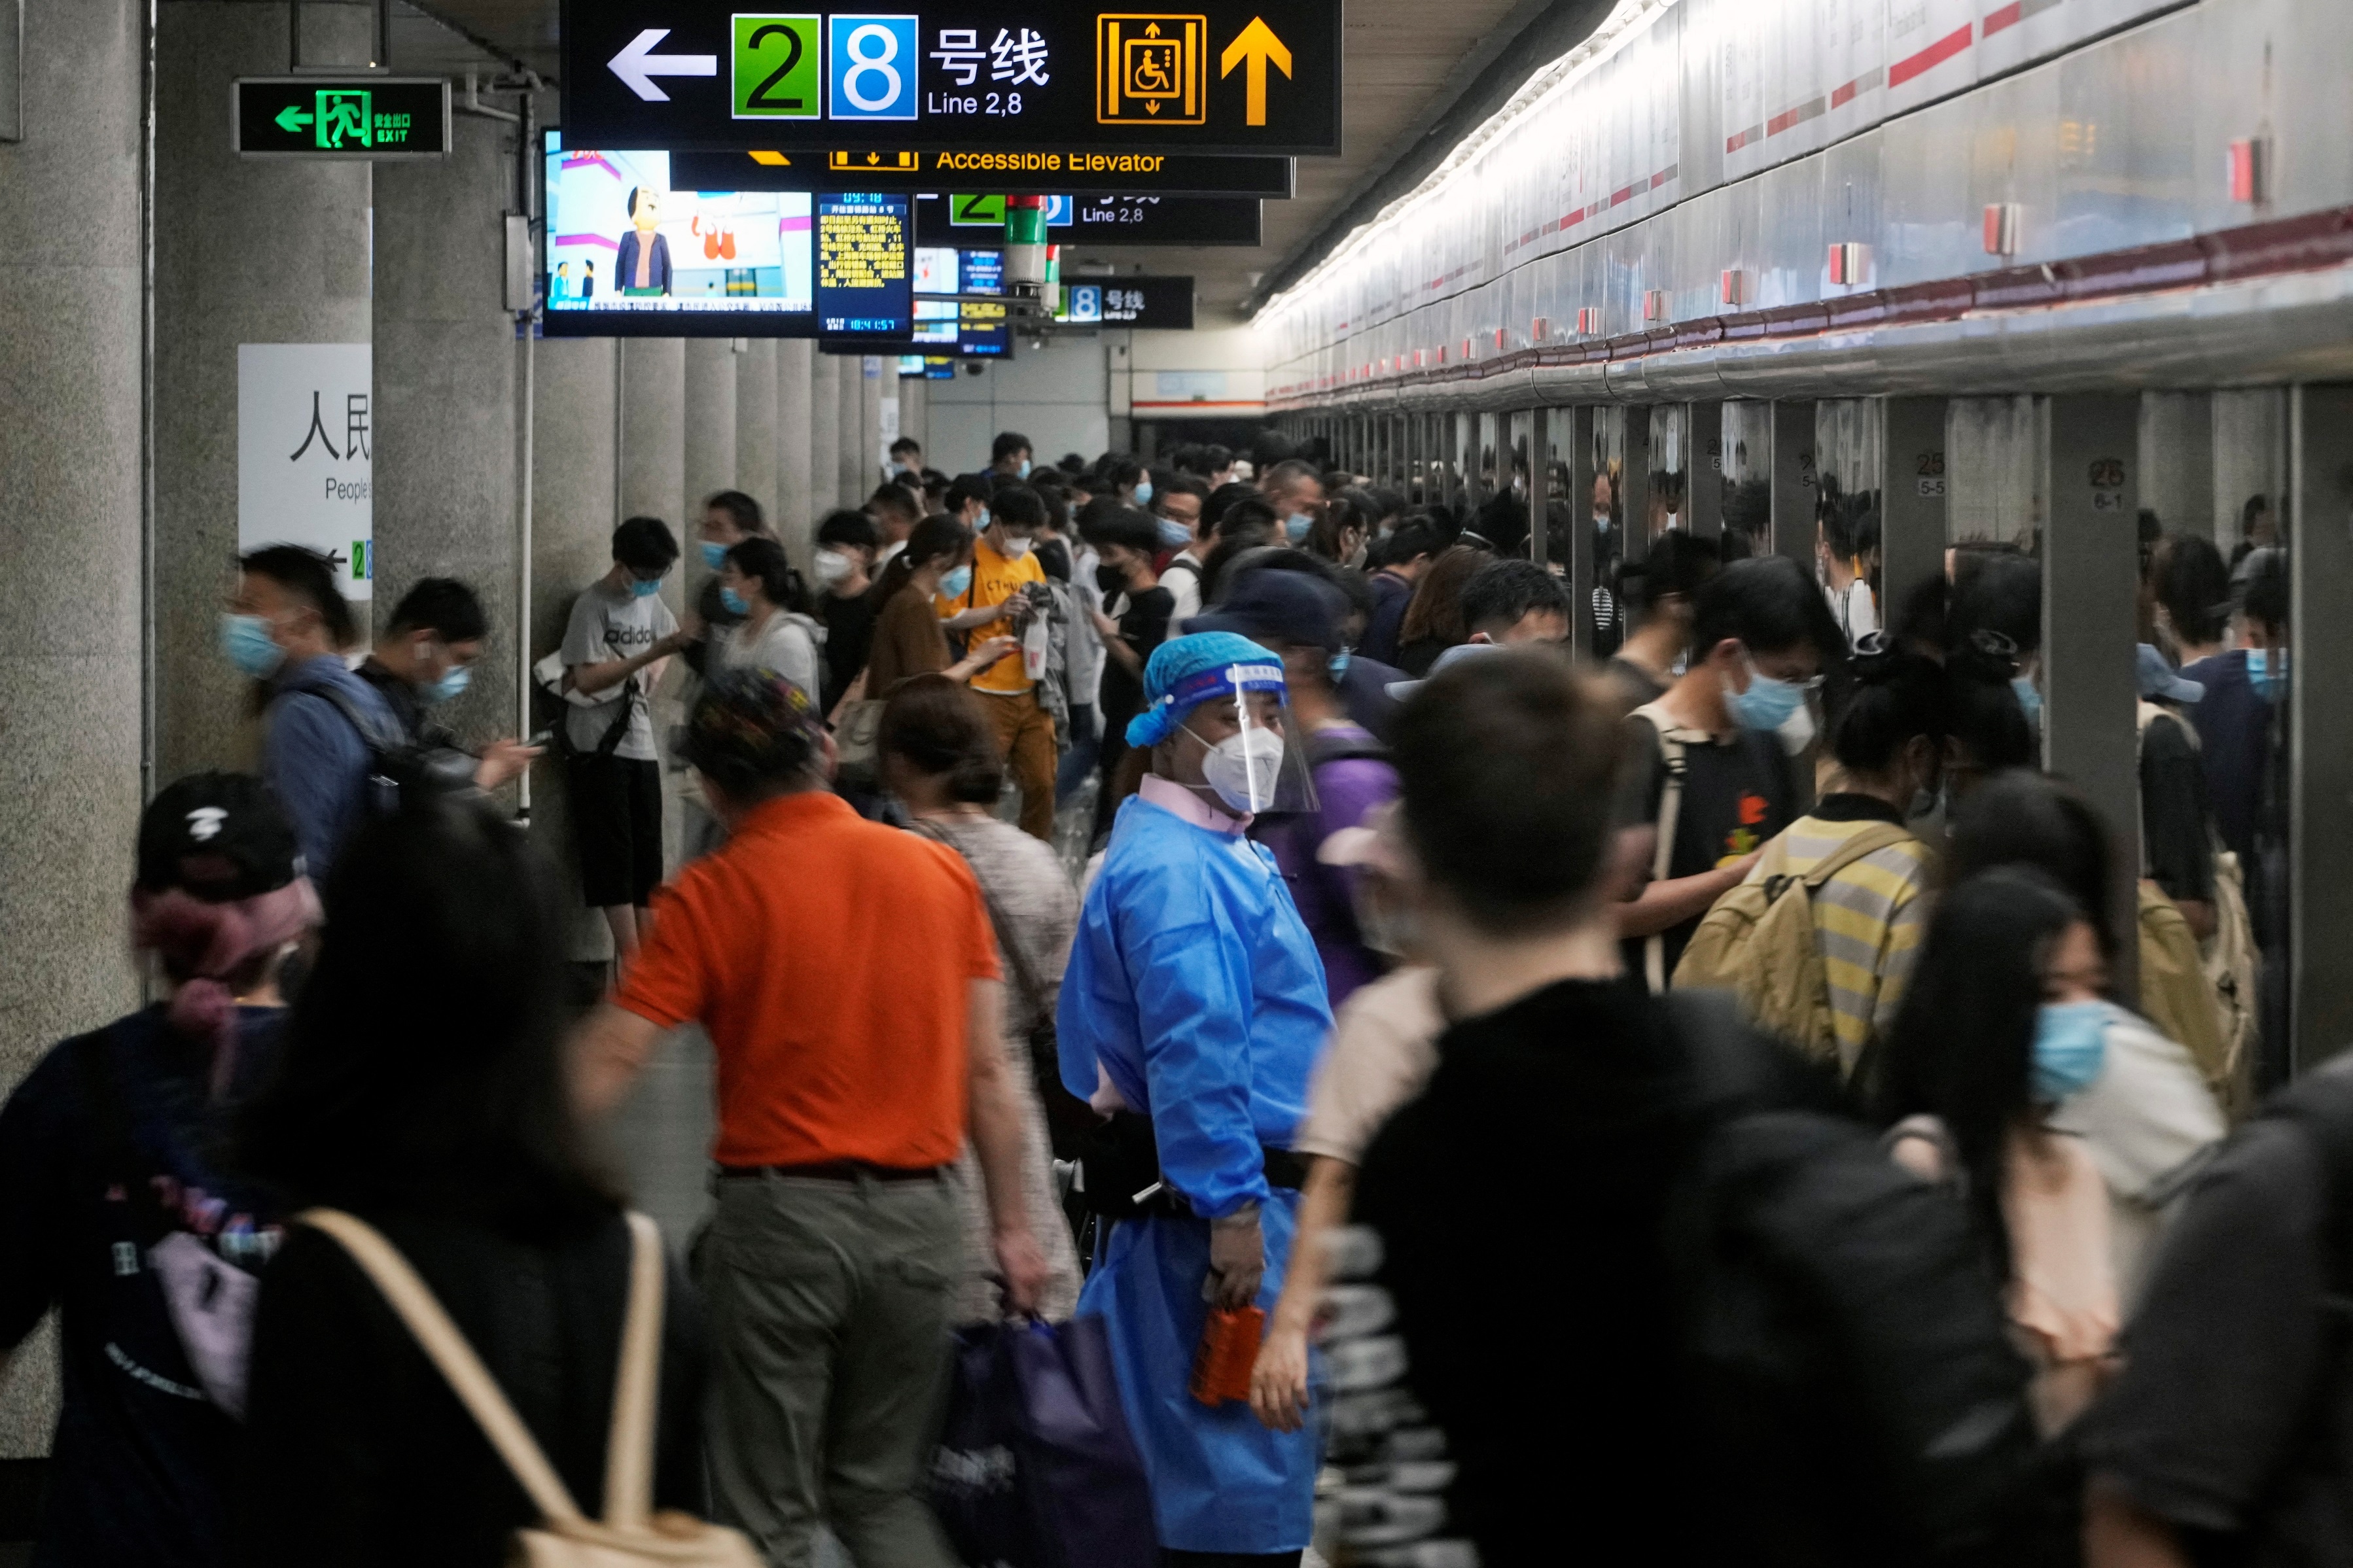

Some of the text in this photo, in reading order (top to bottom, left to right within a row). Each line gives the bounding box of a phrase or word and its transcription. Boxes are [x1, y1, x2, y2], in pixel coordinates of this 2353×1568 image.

[746, 24, 1050, 111] 2 8 号线
[928, 92, 1022, 117] Line 2,8
[374, 113, 410, 129] 安全出口
[377, 129, 408, 143] EXIT
[936, 152, 1164, 172] Accessible Elevator
[1083, 208, 1144, 224] Line 2,8
[1075, 288, 1096, 317] 8
[290, 391, 370, 461] 人民
[1920, 481, 1945, 495] 5-5
[353, 543, 364, 577] 2
